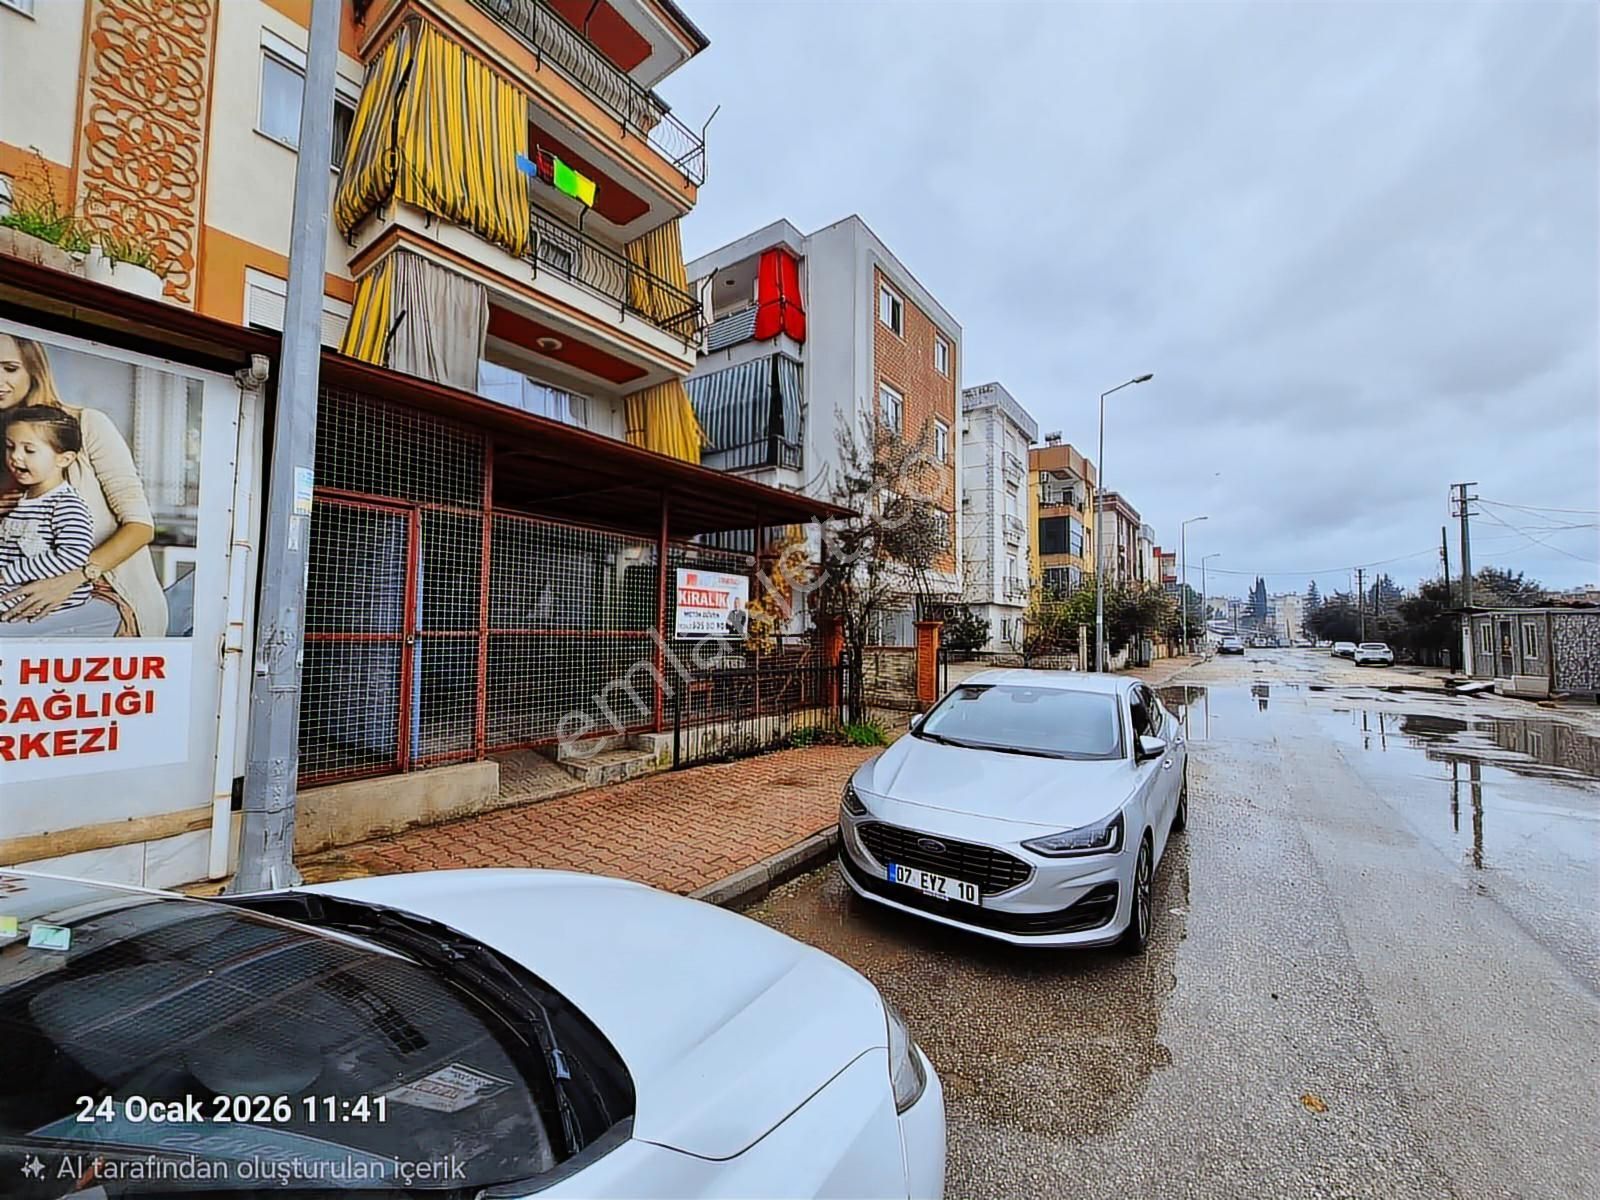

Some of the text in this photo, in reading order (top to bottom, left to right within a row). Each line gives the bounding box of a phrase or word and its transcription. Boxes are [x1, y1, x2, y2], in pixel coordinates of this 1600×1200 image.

[20, 657, 166, 684] HUZUR
[897, 867, 911, 883] 07
[920, 873, 946, 894] EYZ
[959, 883, 974, 901] 10
